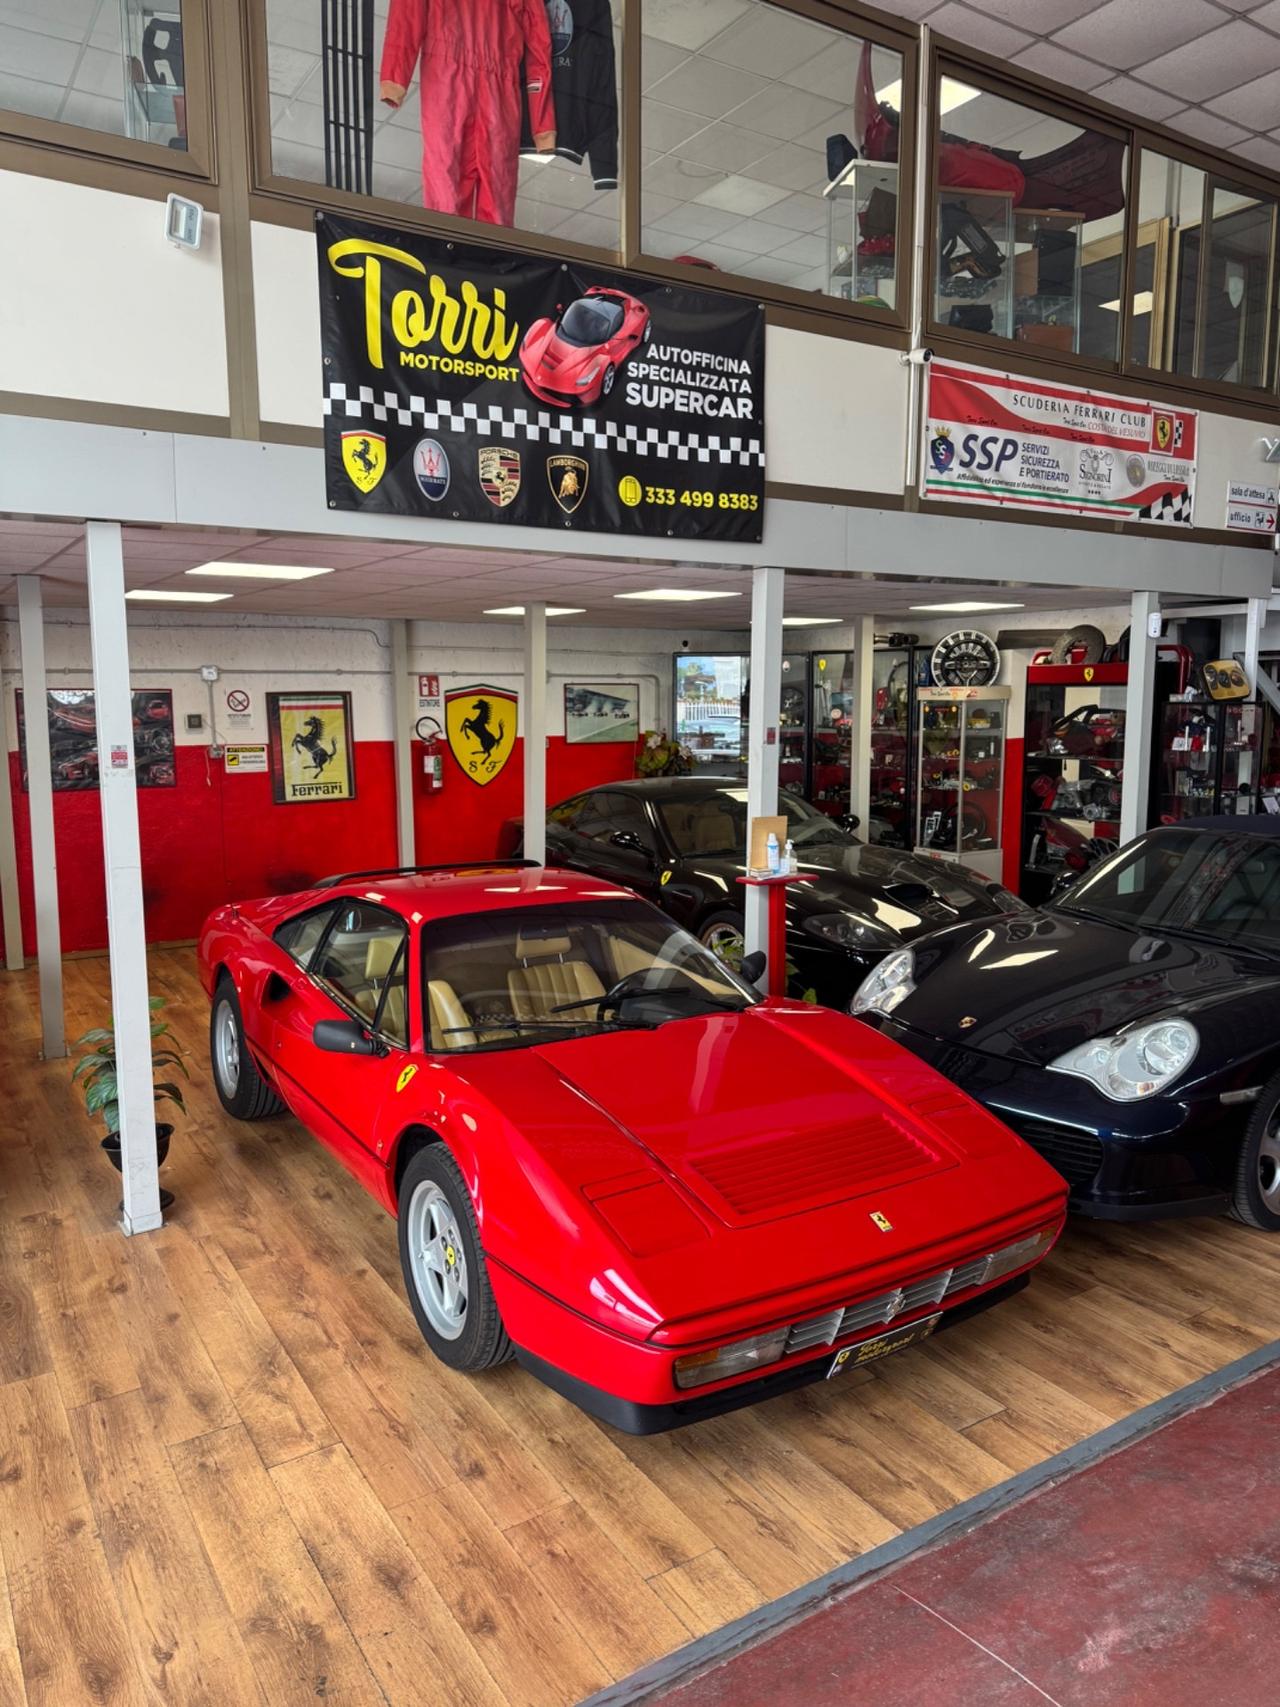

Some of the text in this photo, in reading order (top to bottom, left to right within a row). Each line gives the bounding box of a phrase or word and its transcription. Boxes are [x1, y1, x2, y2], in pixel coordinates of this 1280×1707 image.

[327, 238, 519, 369] Torri
[400, 351, 520, 382] MOTORSPORT
[646, 343, 752, 375] AUTOFFICINA
[627, 361, 752, 394] SPECIALIZZATA
[625, 382, 754, 420] SUPERCAR
[1013, 394, 1070, 414] SCUDERIA
[1074, 404, 1116, 422] FERRARI
[1120, 413, 1146, 428] CLUB
[959, 433, 1018, 472] SSP
[1021, 454, 1060, 470] SICUREZZA
[1022, 442, 1050, 455] SERVIZI
[1019, 467, 1069, 483] E PORTIERATO
[645, 486, 758, 511] 333 499 8383
[1231, 486, 1243, 497] sala
[1230, 511, 1251, 523] ufficio
[292, 782, 343, 796] Ferrari
